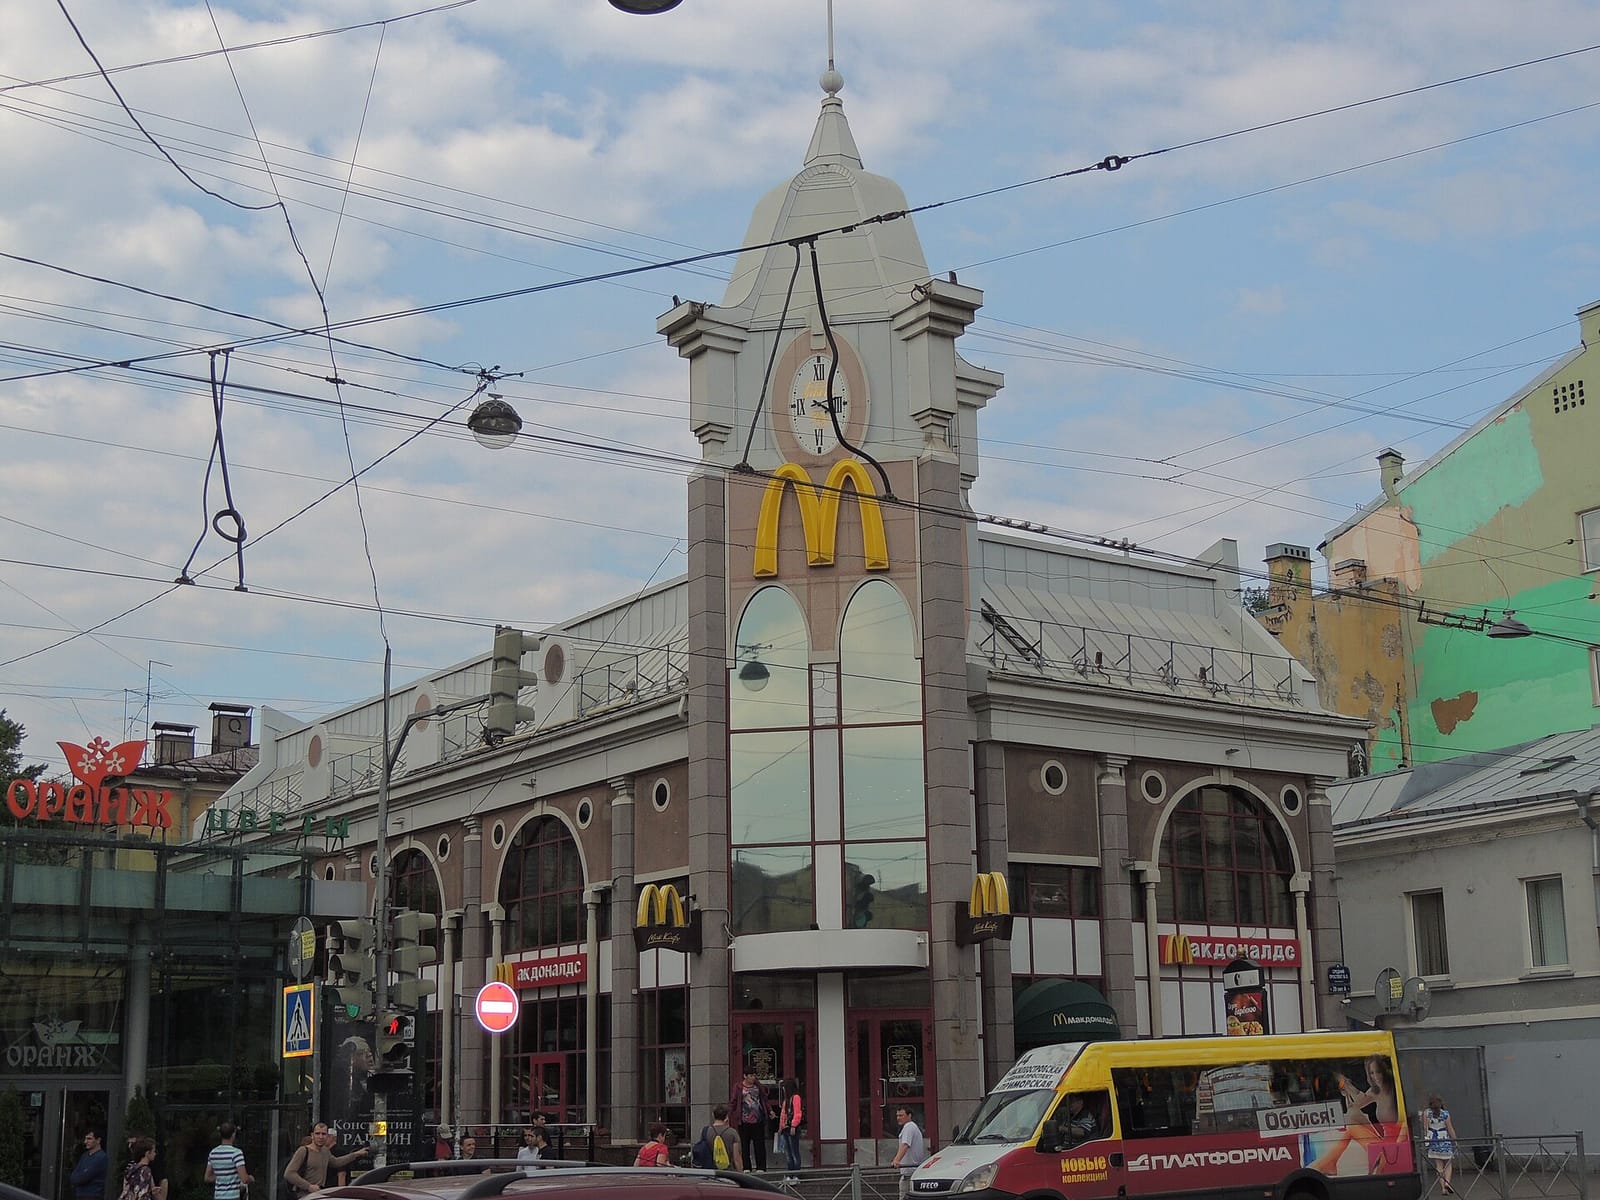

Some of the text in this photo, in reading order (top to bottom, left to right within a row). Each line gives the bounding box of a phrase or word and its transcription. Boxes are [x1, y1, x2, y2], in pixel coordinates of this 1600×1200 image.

[813, 364, 824, 381] XII
[797, 399, 805, 415] IX
[815, 429, 823, 446] VI
[7, 779, 173, 828] ОРАНЖ
[207, 808, 350, 838] ЦВЕТЫ
[6, 1046, 97, 1067] ОРАНЖ
[333, 1120, 411, 1129] Констин
[1265, 1108, 1336, 1130] Обуйся!
[343, 1133, 411, 1145] РАИН
[1152, 1147, 1292, 1170] ПЛАТФОРМА
[920, 1182, 939, 1190] IVECO
